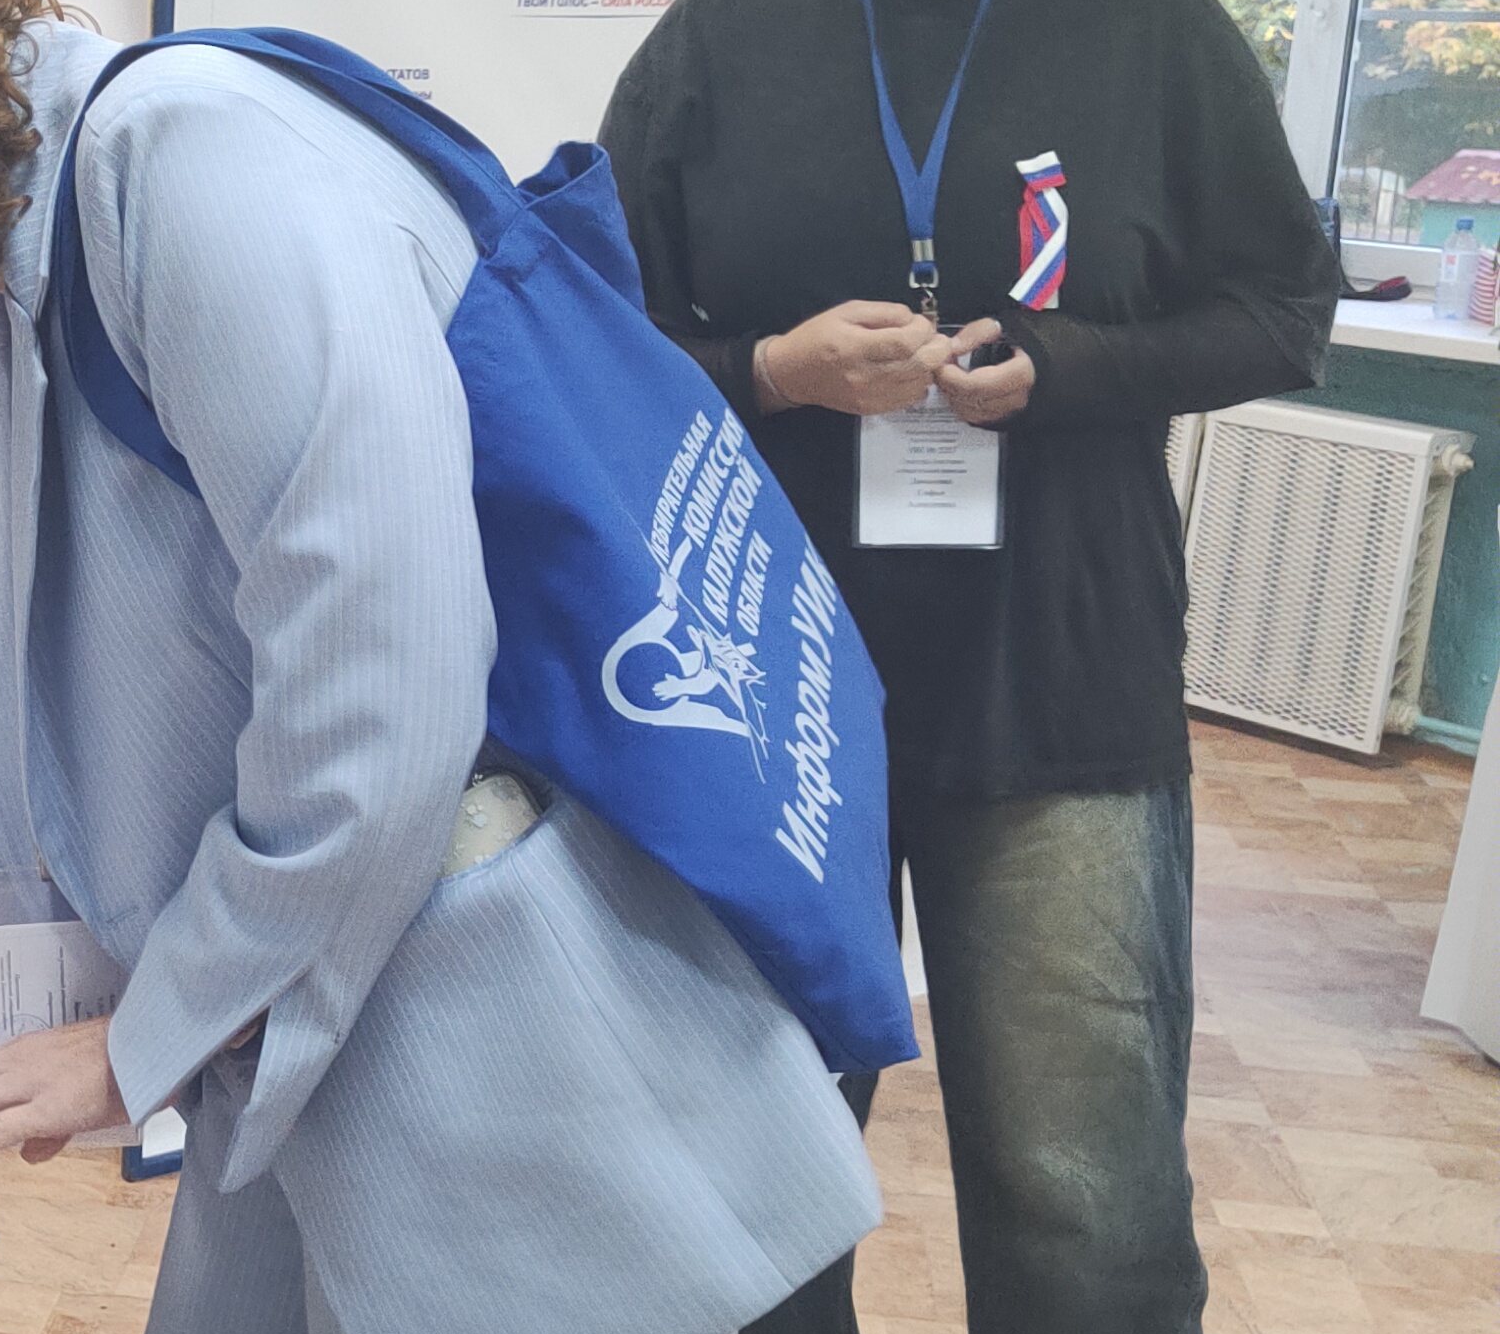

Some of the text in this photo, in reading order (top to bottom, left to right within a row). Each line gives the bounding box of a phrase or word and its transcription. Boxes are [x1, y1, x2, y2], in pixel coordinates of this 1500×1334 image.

[650, 409, 713, 564] ИЗБИРАТЕЛЬНАЯ
[681, 407, 744, 550] КОМИССИЯ
[702, 454, 762, 627] КАЛУЖСКОЙ
[736, 529, 773, 637] ОБЛАСТИ
